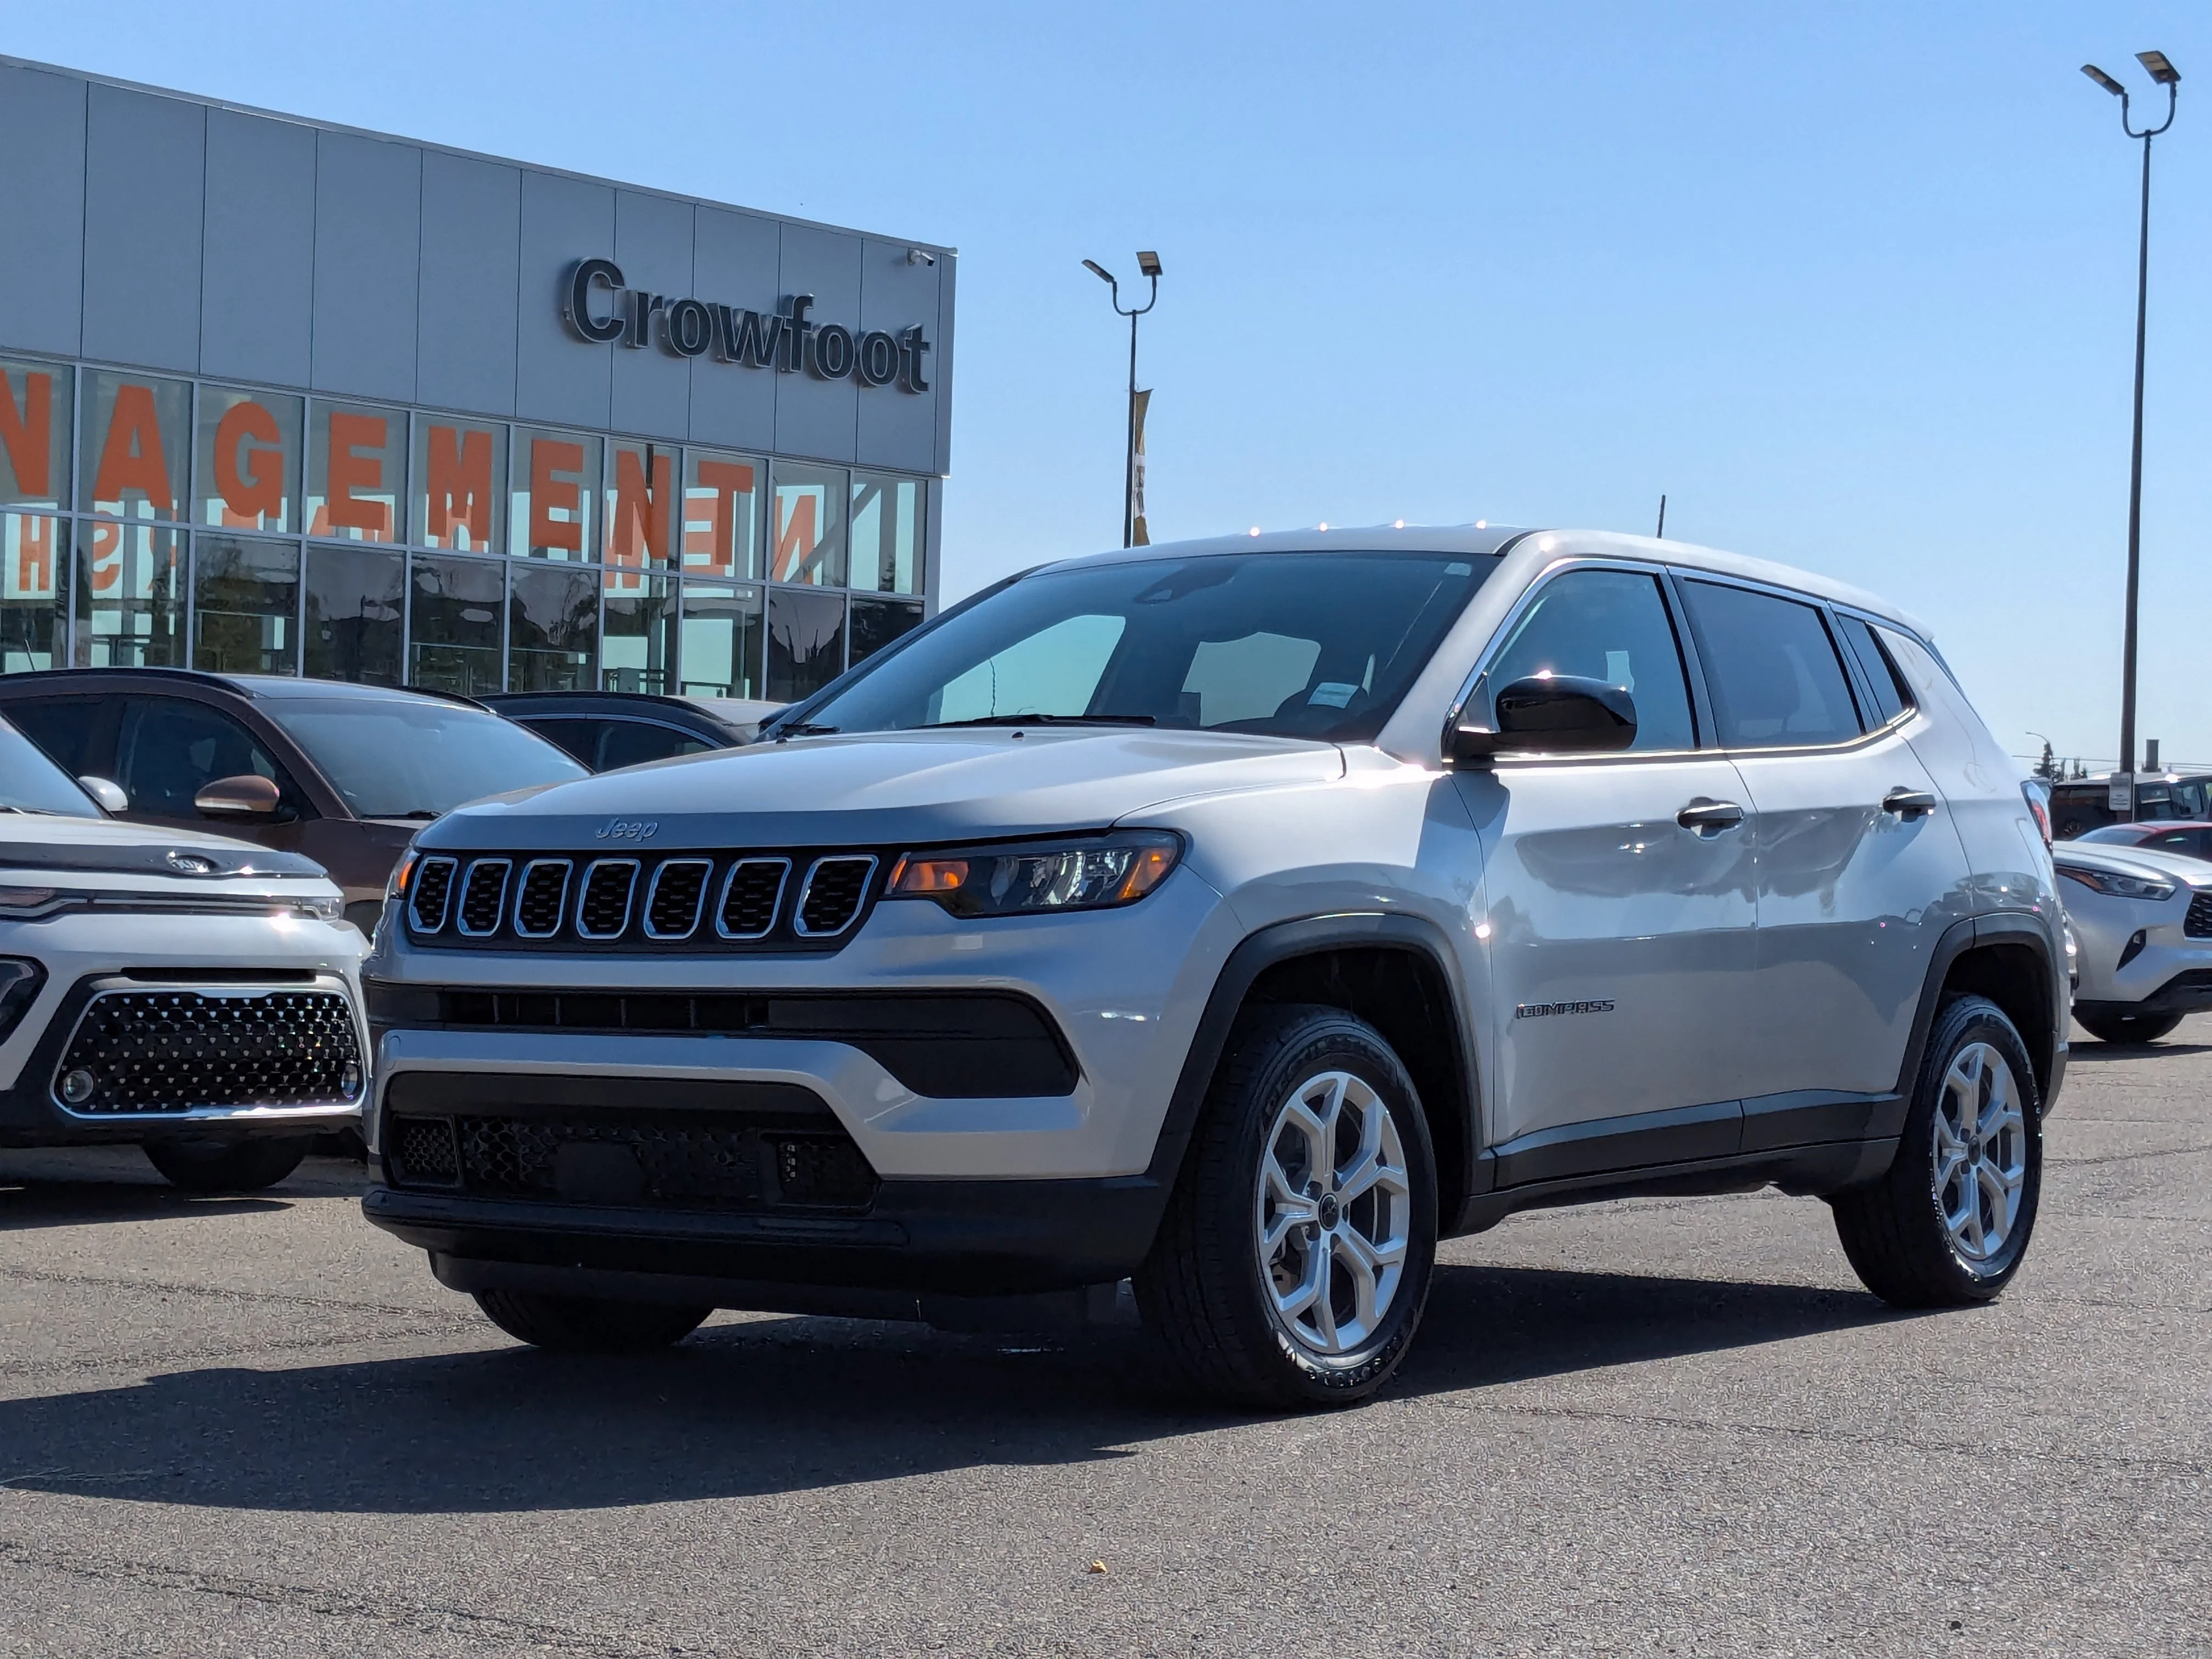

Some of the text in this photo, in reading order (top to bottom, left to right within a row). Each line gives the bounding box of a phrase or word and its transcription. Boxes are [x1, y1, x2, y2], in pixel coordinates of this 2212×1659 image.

[567, 256, 930, 394] Crowfoot
[595, 817, 658, 843] Jeep
[1516, 998, 1616, 1019] COMPASS
